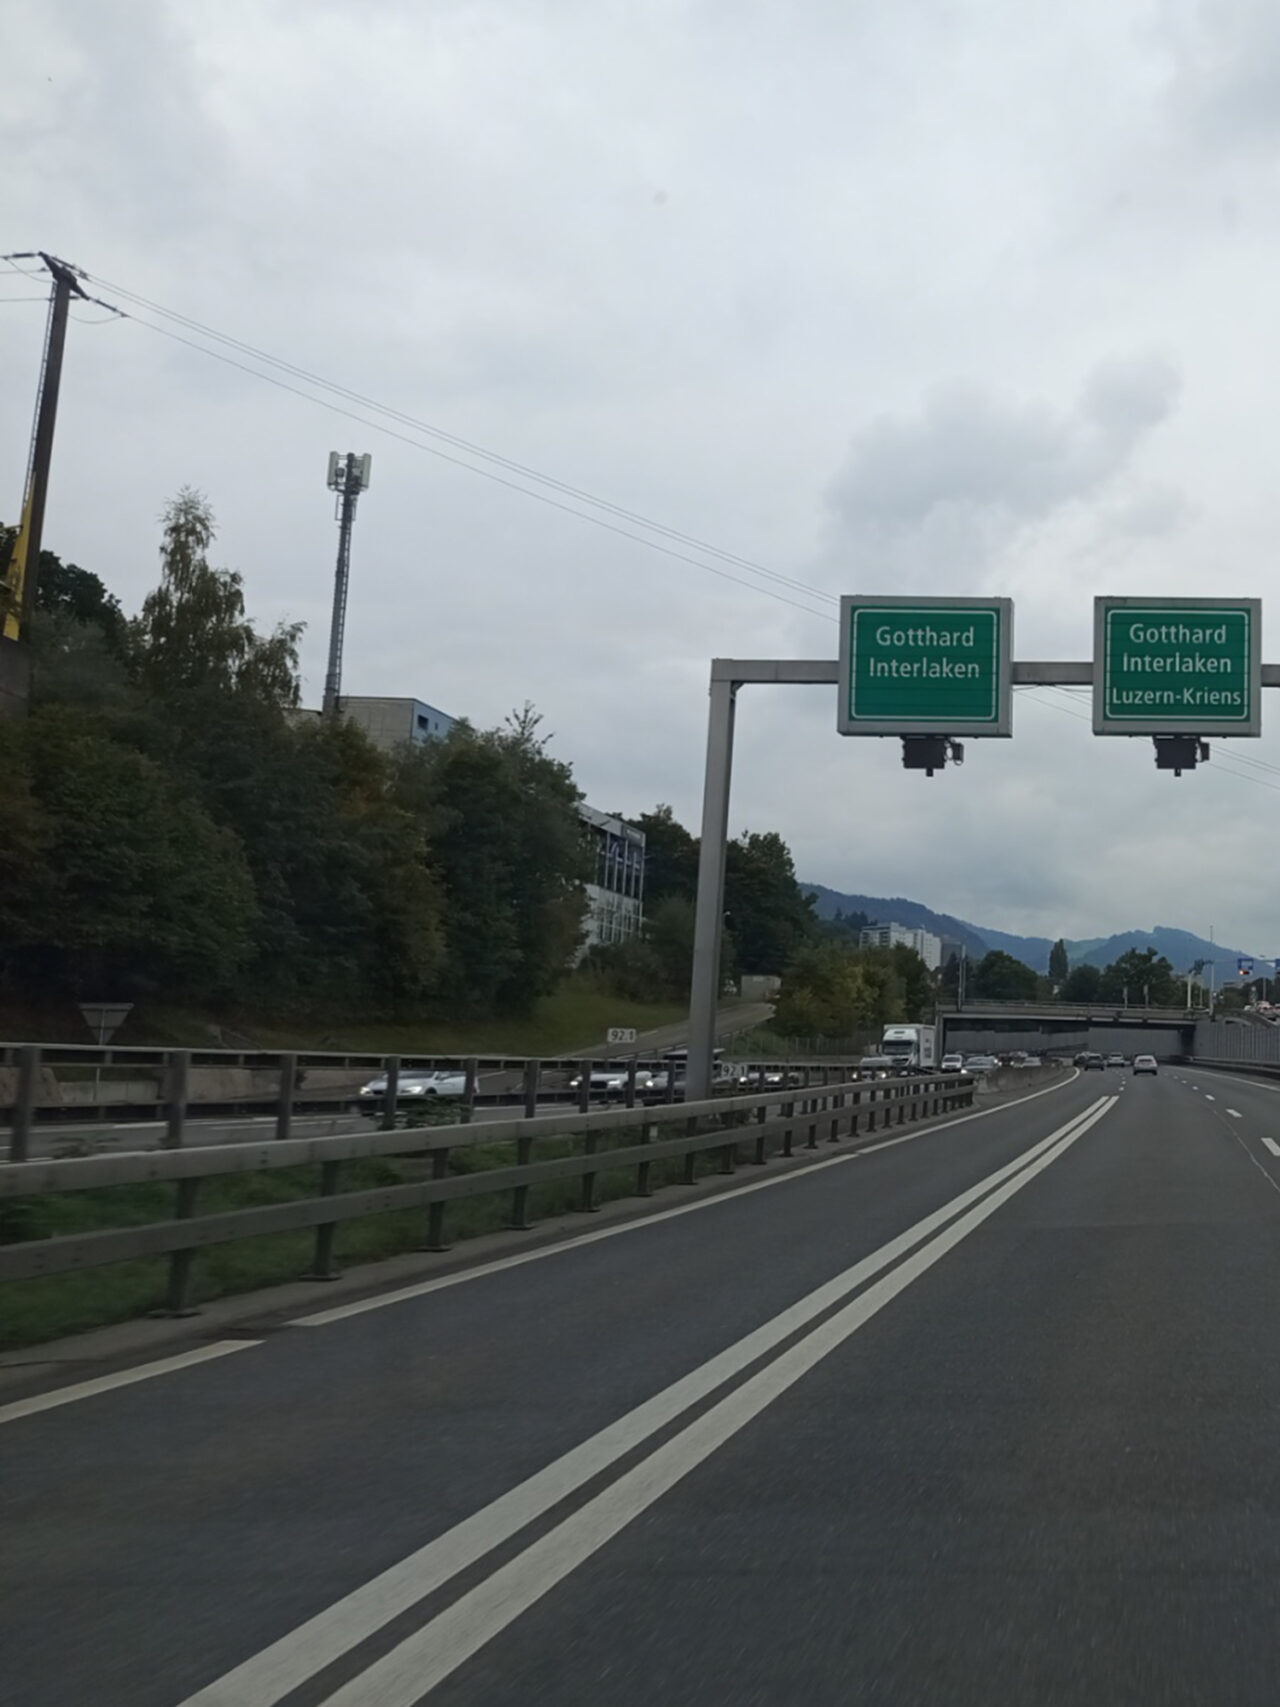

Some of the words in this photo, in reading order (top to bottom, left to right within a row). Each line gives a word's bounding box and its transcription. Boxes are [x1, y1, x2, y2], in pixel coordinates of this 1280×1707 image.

[875, 625, 975, 647] Gotthard
[1129, 623, 1227, 645] Gotthard
[869, 657, 980, 679] Interlaken
[1123, 652, 1232, 673] Interlaken
[1112, 687, 1242, 705] Luzern-Kriens
[611, 1030, 635, 1041] 92.1
